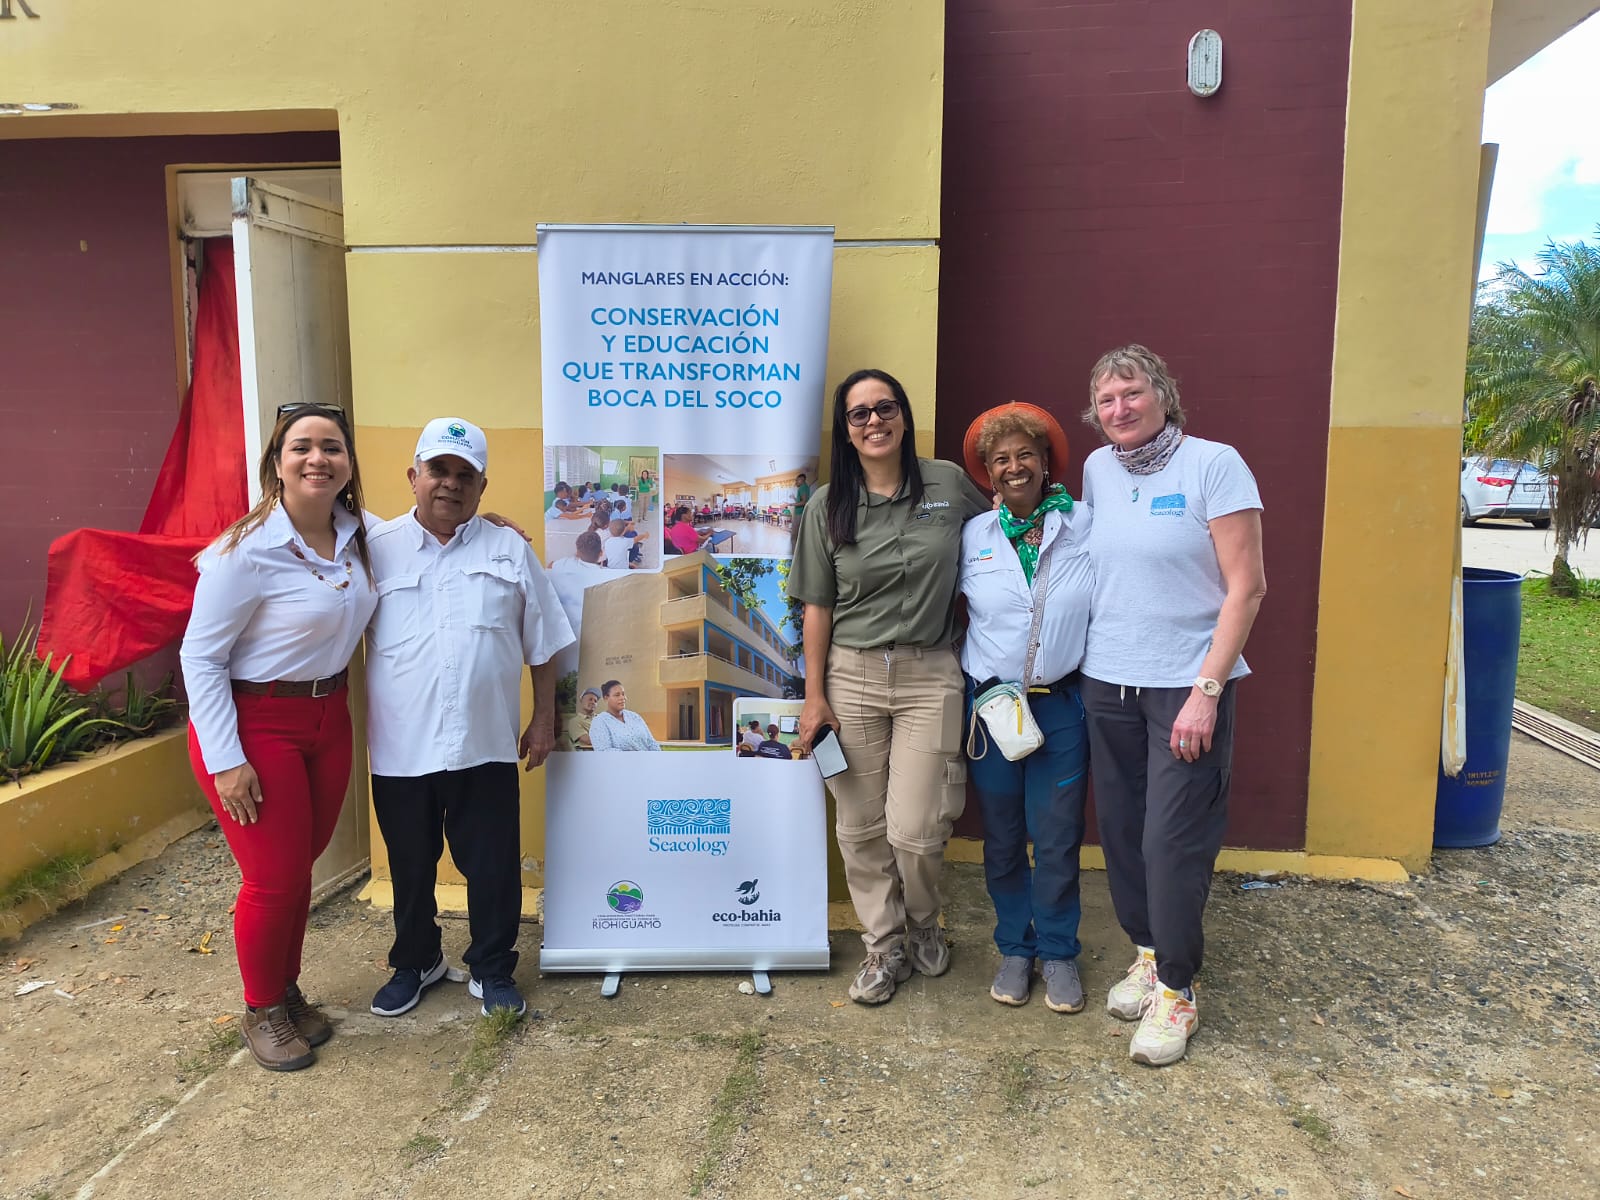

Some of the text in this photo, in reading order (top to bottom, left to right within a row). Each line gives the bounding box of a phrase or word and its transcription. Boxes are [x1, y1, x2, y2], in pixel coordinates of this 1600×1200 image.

[581, 268, 789, 287] MANGLARES EN ACCIÓN:
[590, 303, 779, 327] CONSERVACIÓN
[601, 330, 769, 354] Y EDUCACIÓN
[562, 361, 801, 383] QUE TRANSFORMAN
[588, 389, 782, 409] BOCA DEL SOCO
[648, 836, 731, 857] Seacology
[592, 920, 662, 930] RIOHIGUAMO
